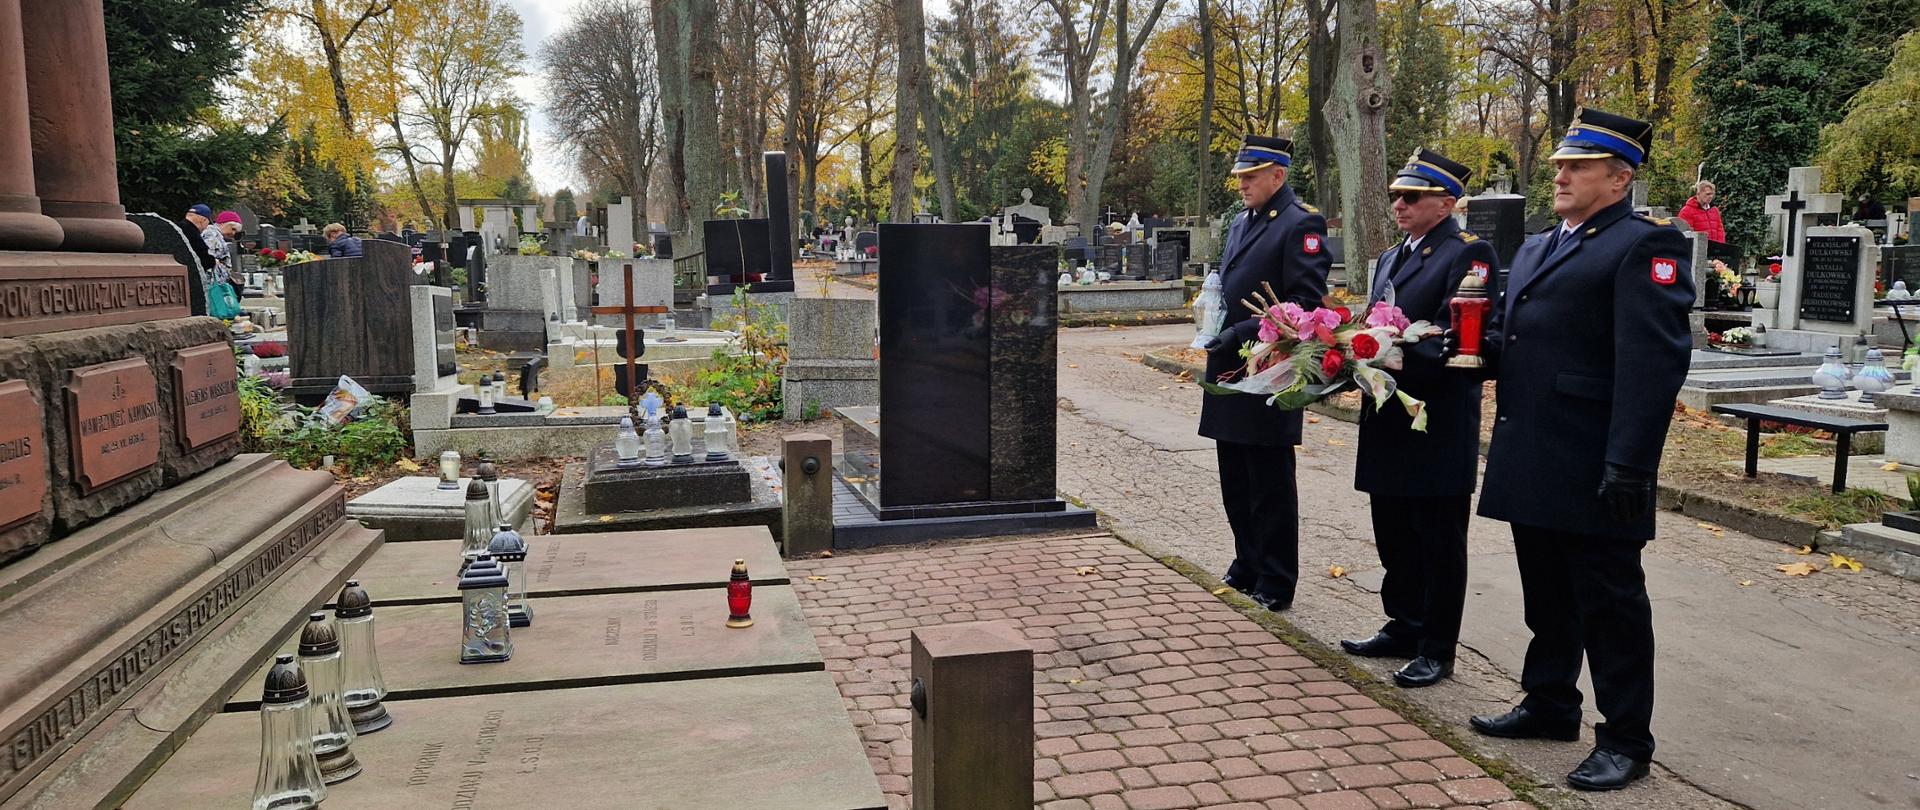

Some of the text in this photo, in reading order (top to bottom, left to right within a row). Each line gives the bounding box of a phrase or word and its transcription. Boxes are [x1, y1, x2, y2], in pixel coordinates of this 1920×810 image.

[96, 622, 182, 706] PODCZAS
[245, 563, 255, 589] W
[405, 740, 446, 788] TOPORNIK
